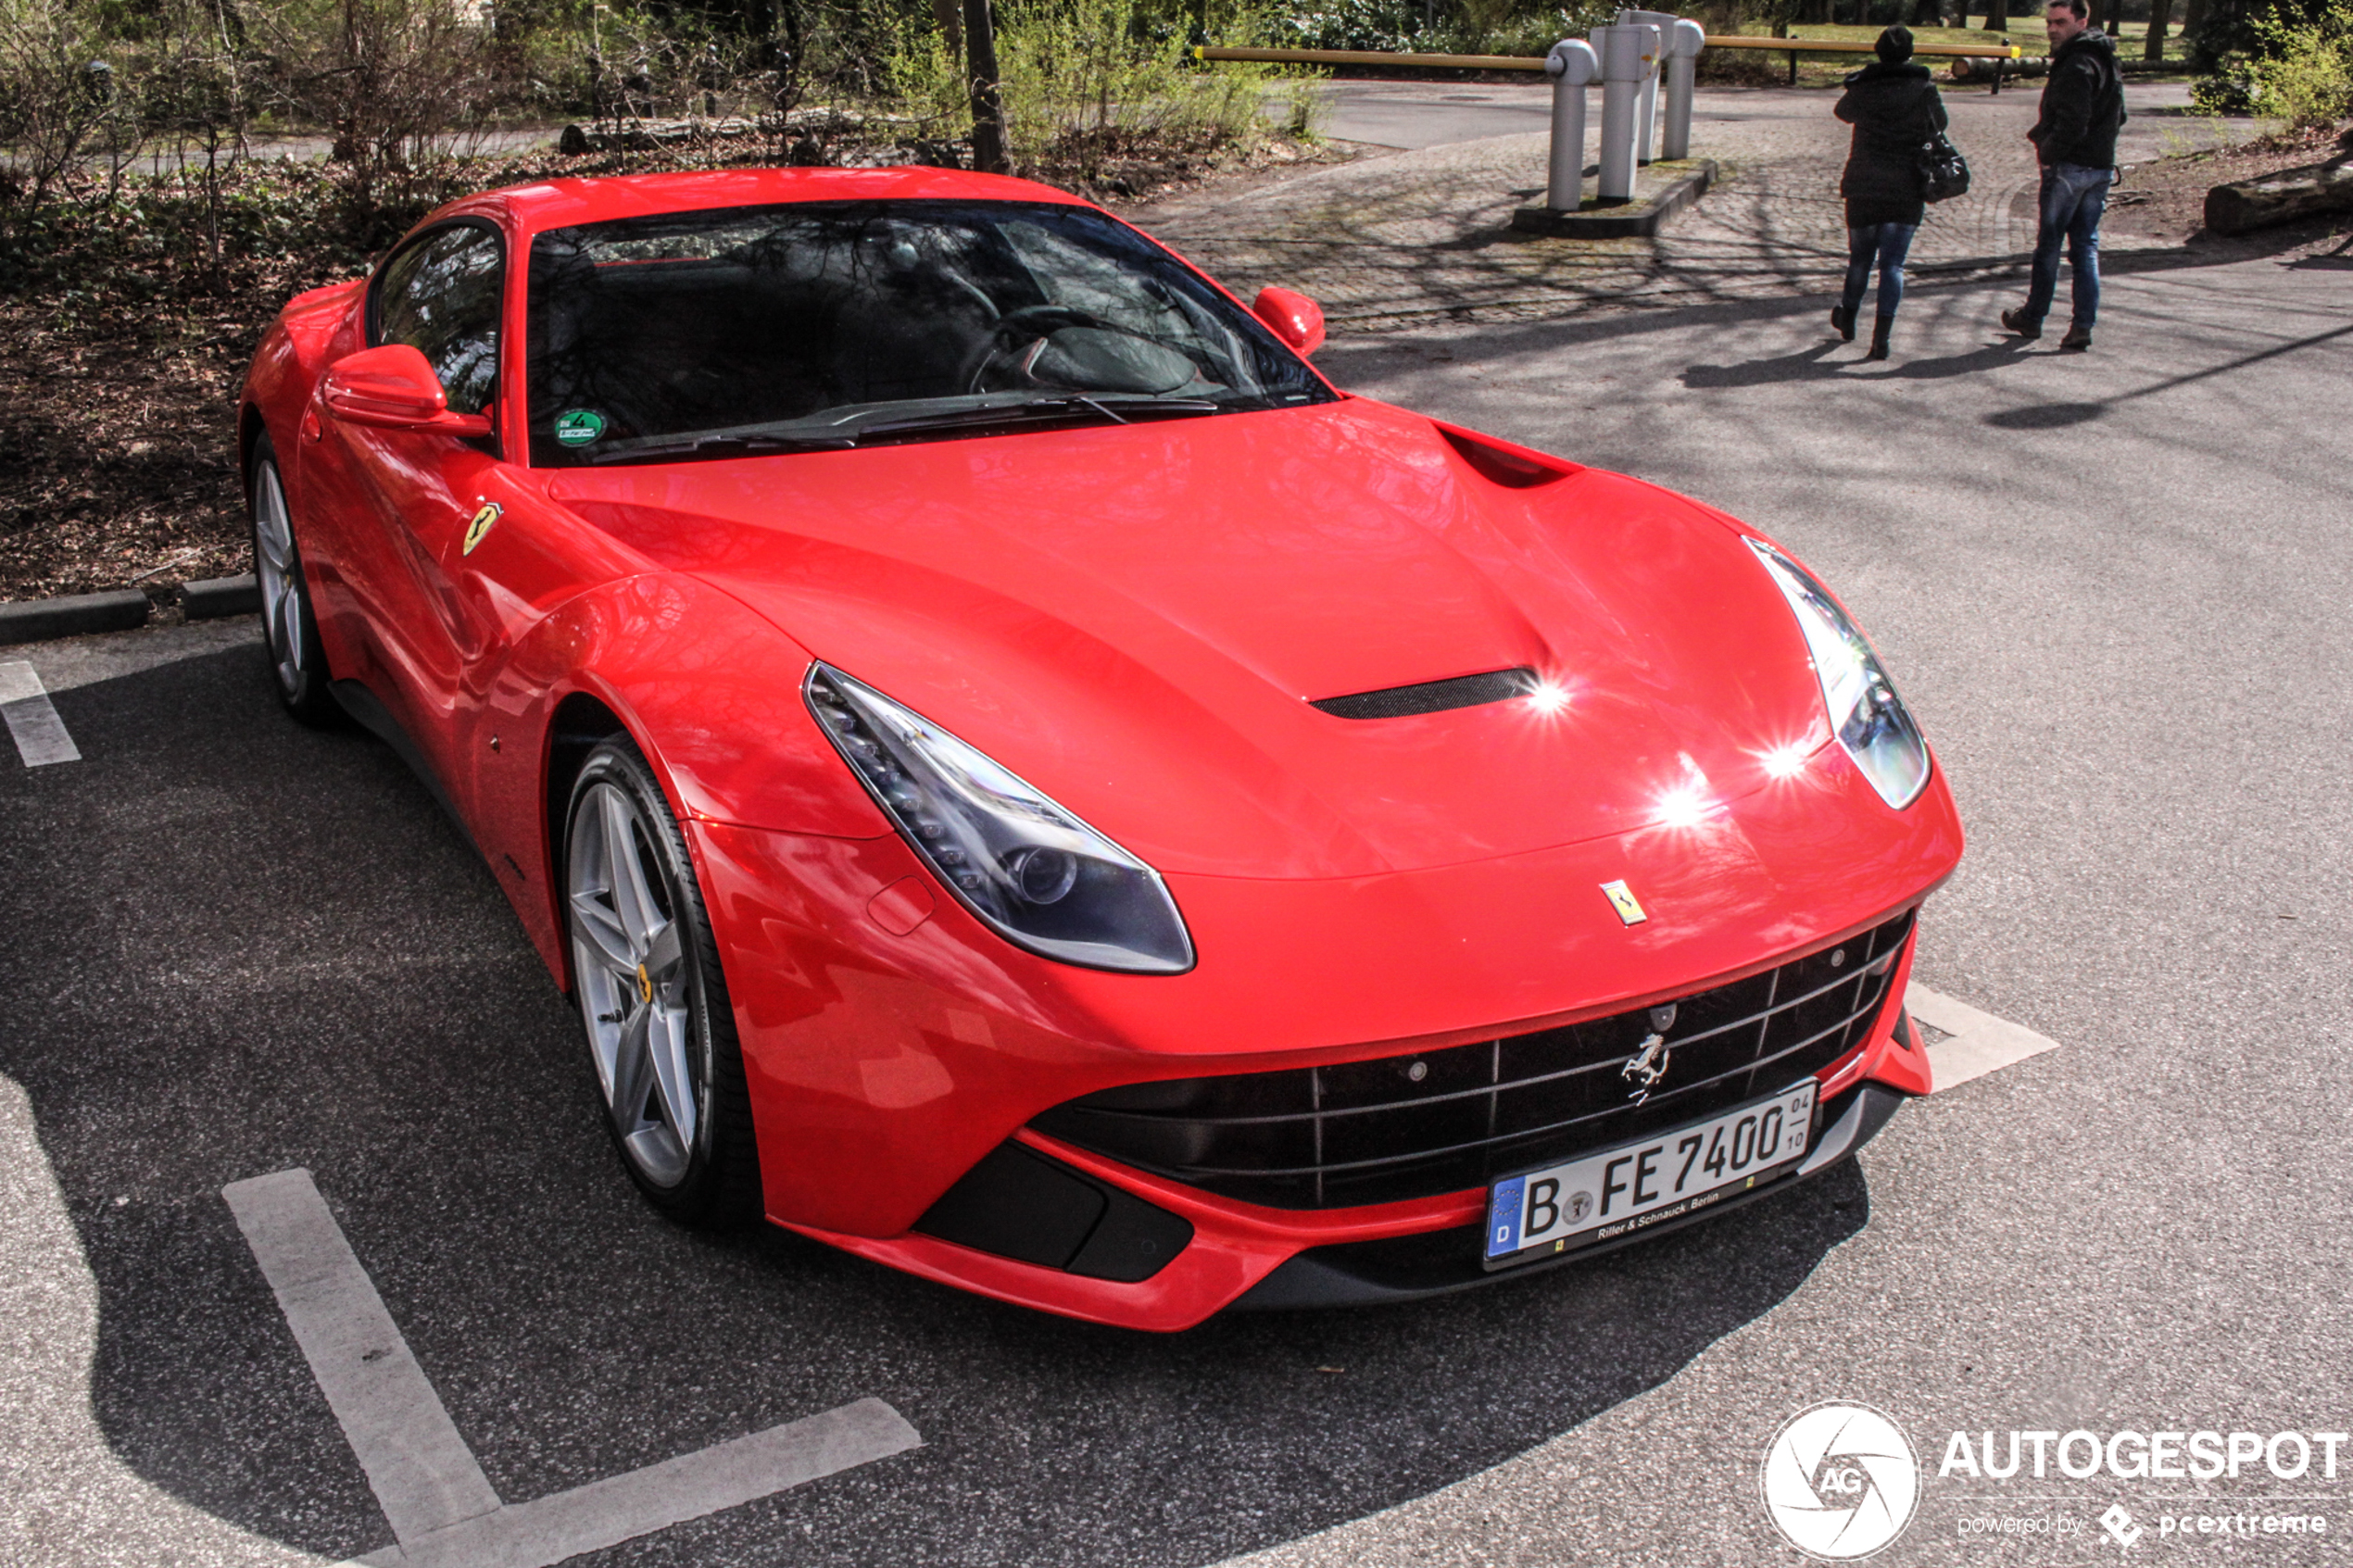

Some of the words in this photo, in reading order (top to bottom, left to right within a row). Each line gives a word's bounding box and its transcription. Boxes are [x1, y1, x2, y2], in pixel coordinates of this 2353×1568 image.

[573, 414, 585, 427] 4
[1792, 1094, 1808, 1113] 04
[1788, 1132, 1804, 1150] 10
[1524, 1177, 1560, 1238] B
[1600, 1145, 1664, 1217] FE
[1674, 1105, 1783, 1193] 7400
[1598, 1223, 1626, 1239] Riller
[1628, 1219, 1635, 1231] &
[1638, 1203, 1686, 1227] Schnauck
[1691, 1192, 1719, 1210] Berlin
[1497, 1225, 1510, 1244] D
